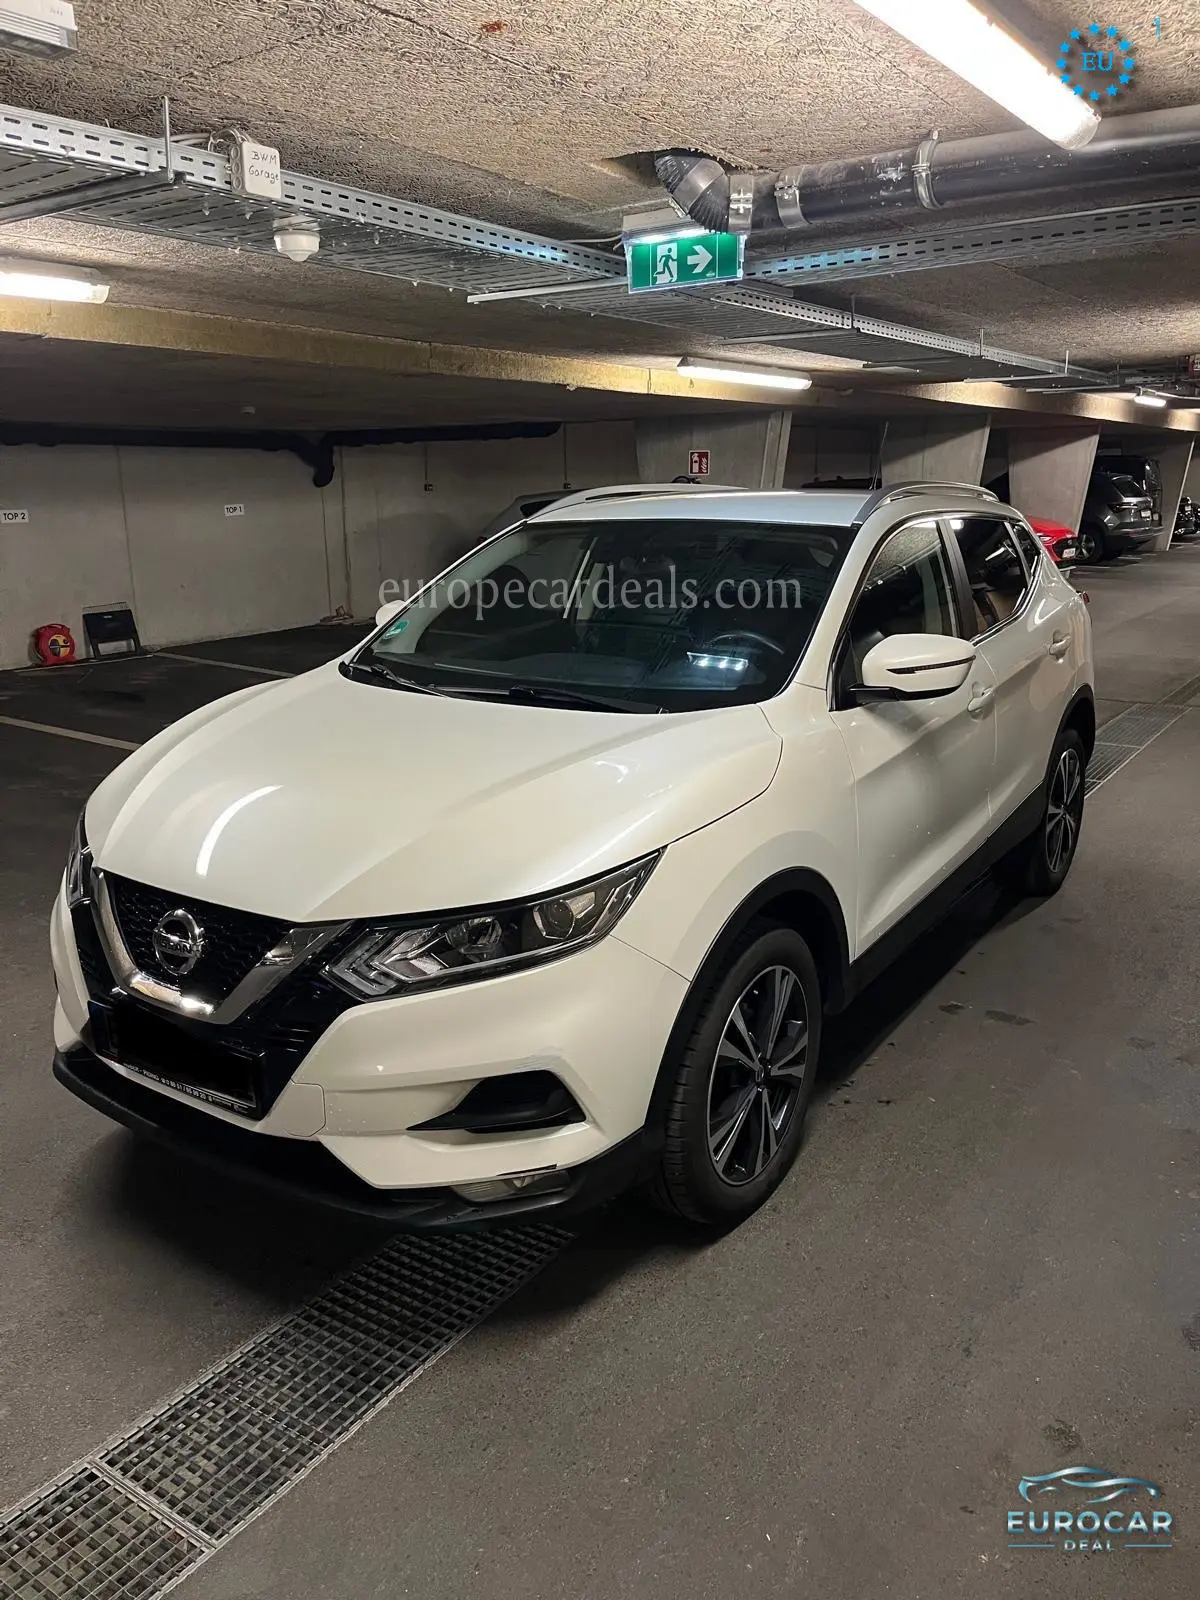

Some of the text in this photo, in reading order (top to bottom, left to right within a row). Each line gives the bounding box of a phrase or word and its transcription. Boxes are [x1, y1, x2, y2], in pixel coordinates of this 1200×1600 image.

[252, 150, 278, 165] BWM
[248, 164, 279, 185] Garage
[226, 506, 238, 514] TOP
[3, 512, 26, 521] TOP 2
